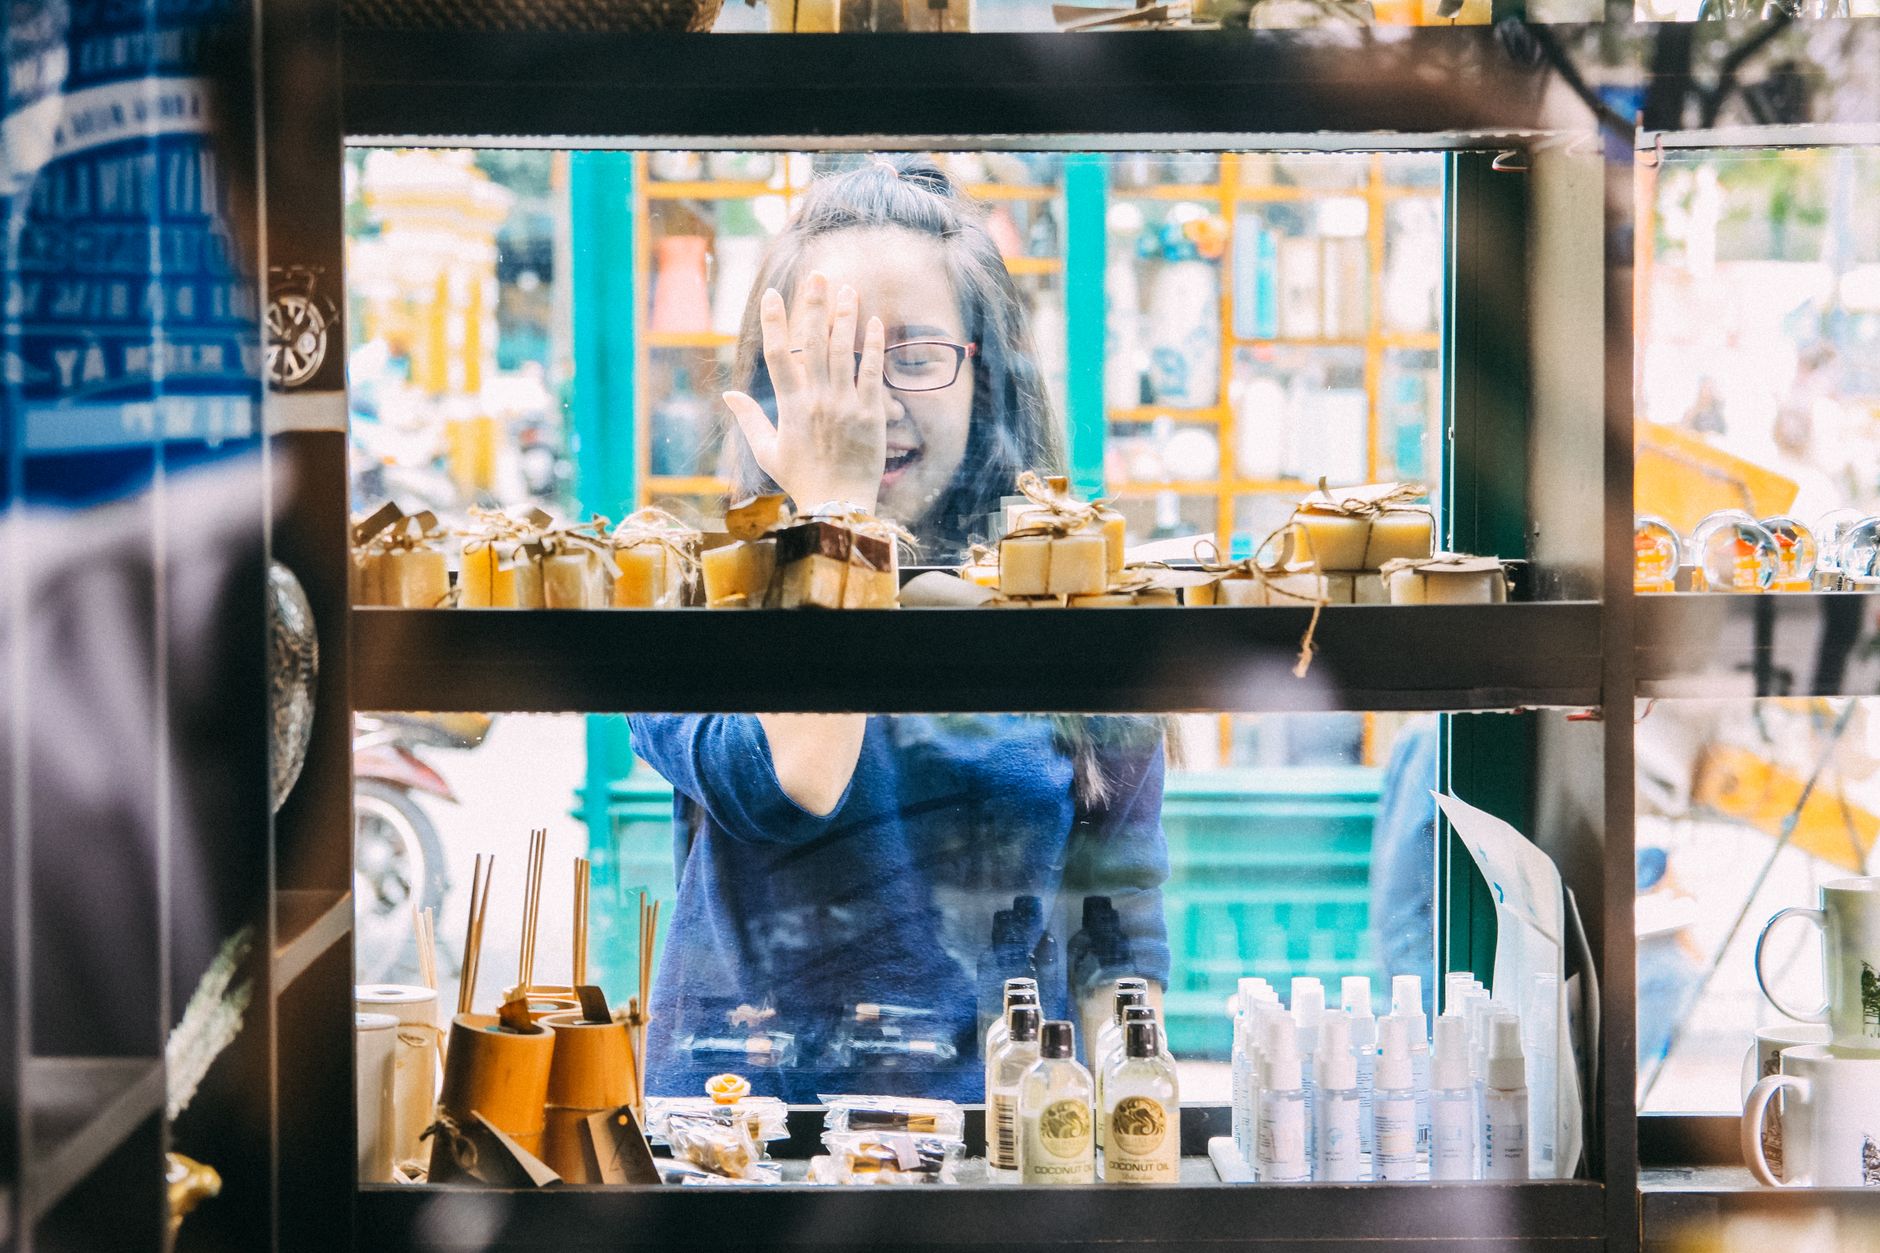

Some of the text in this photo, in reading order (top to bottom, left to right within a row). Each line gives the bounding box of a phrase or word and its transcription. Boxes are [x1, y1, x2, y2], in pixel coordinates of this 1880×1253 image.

[1034, 1164, 1082, 1175] COCONUT
[1109, 1160, 1154, 1172] COCONUT
[1156, 1162, 1169, 1171] OIL
